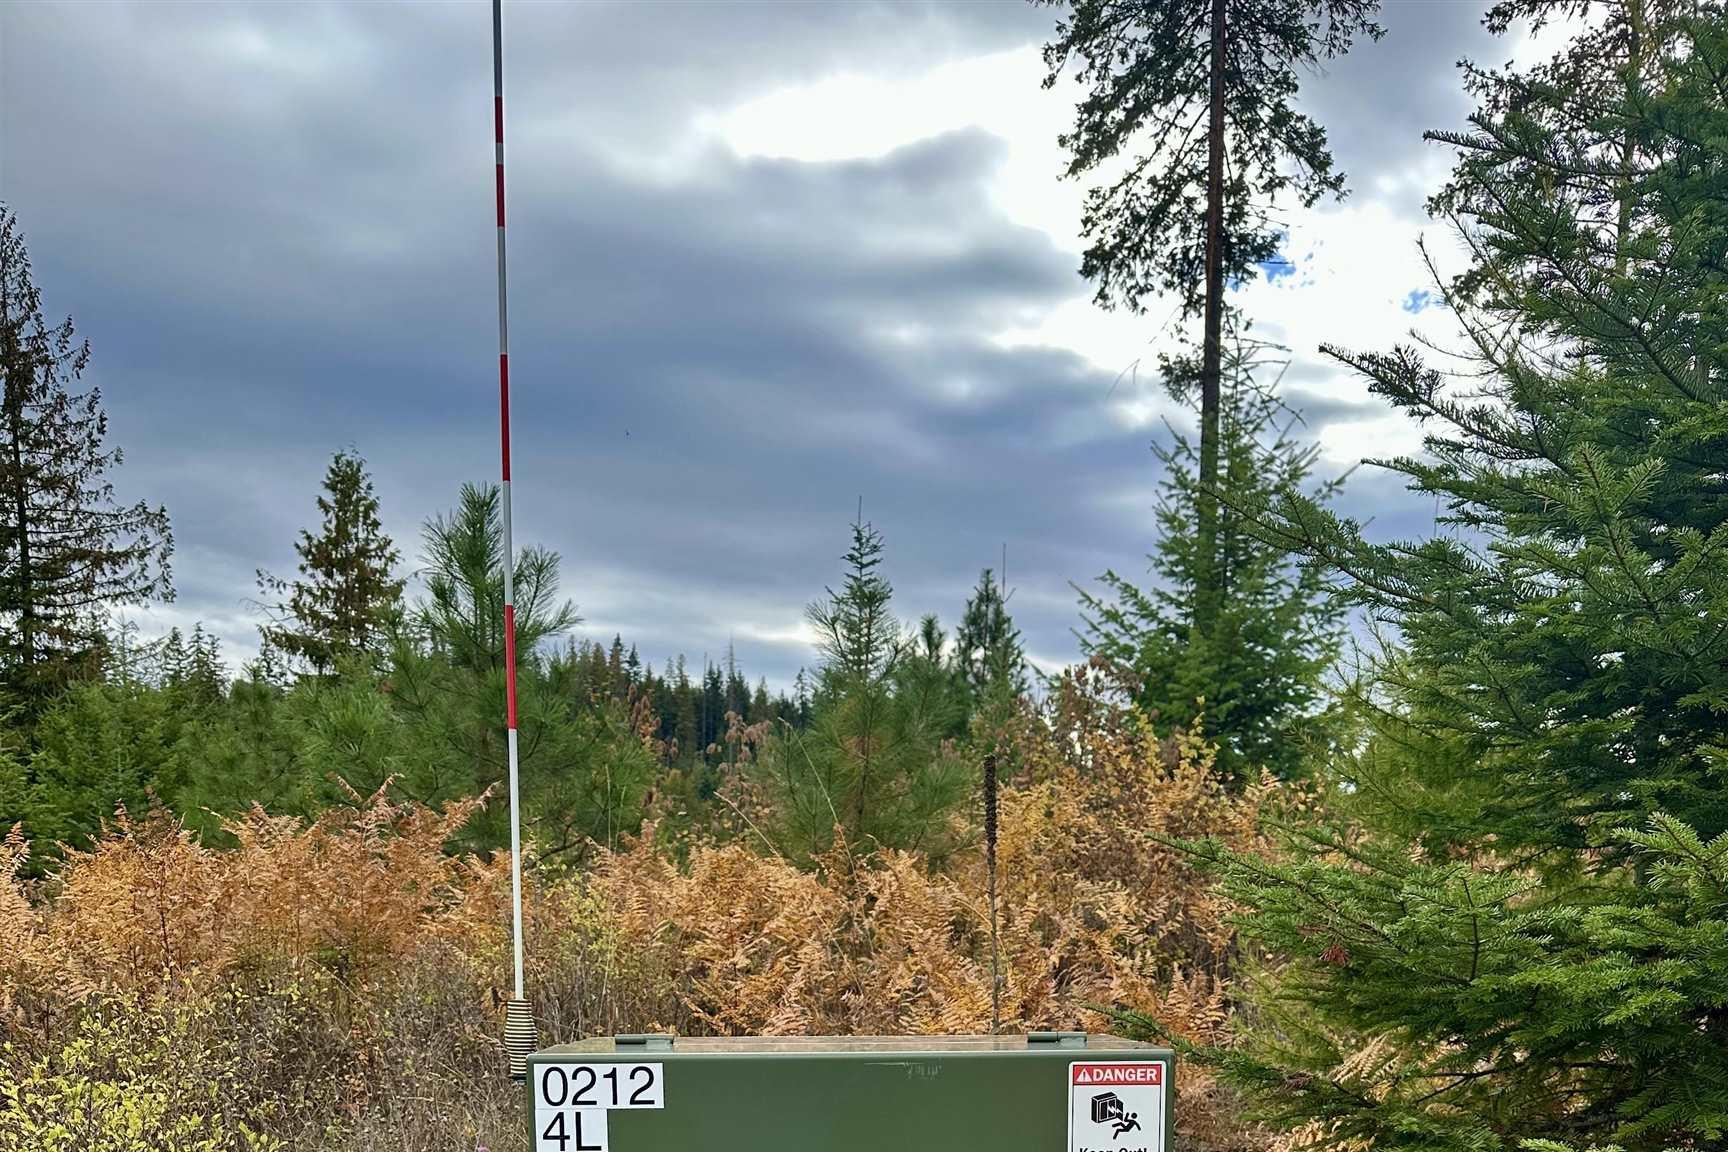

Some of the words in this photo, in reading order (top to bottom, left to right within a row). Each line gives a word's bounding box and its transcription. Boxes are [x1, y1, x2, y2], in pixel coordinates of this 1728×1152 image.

[542, 1066, 655, 1106] 0212
[1092, 1068, 1157, 1081] DANGER
[542, 1111, 602, 1152] 4L
